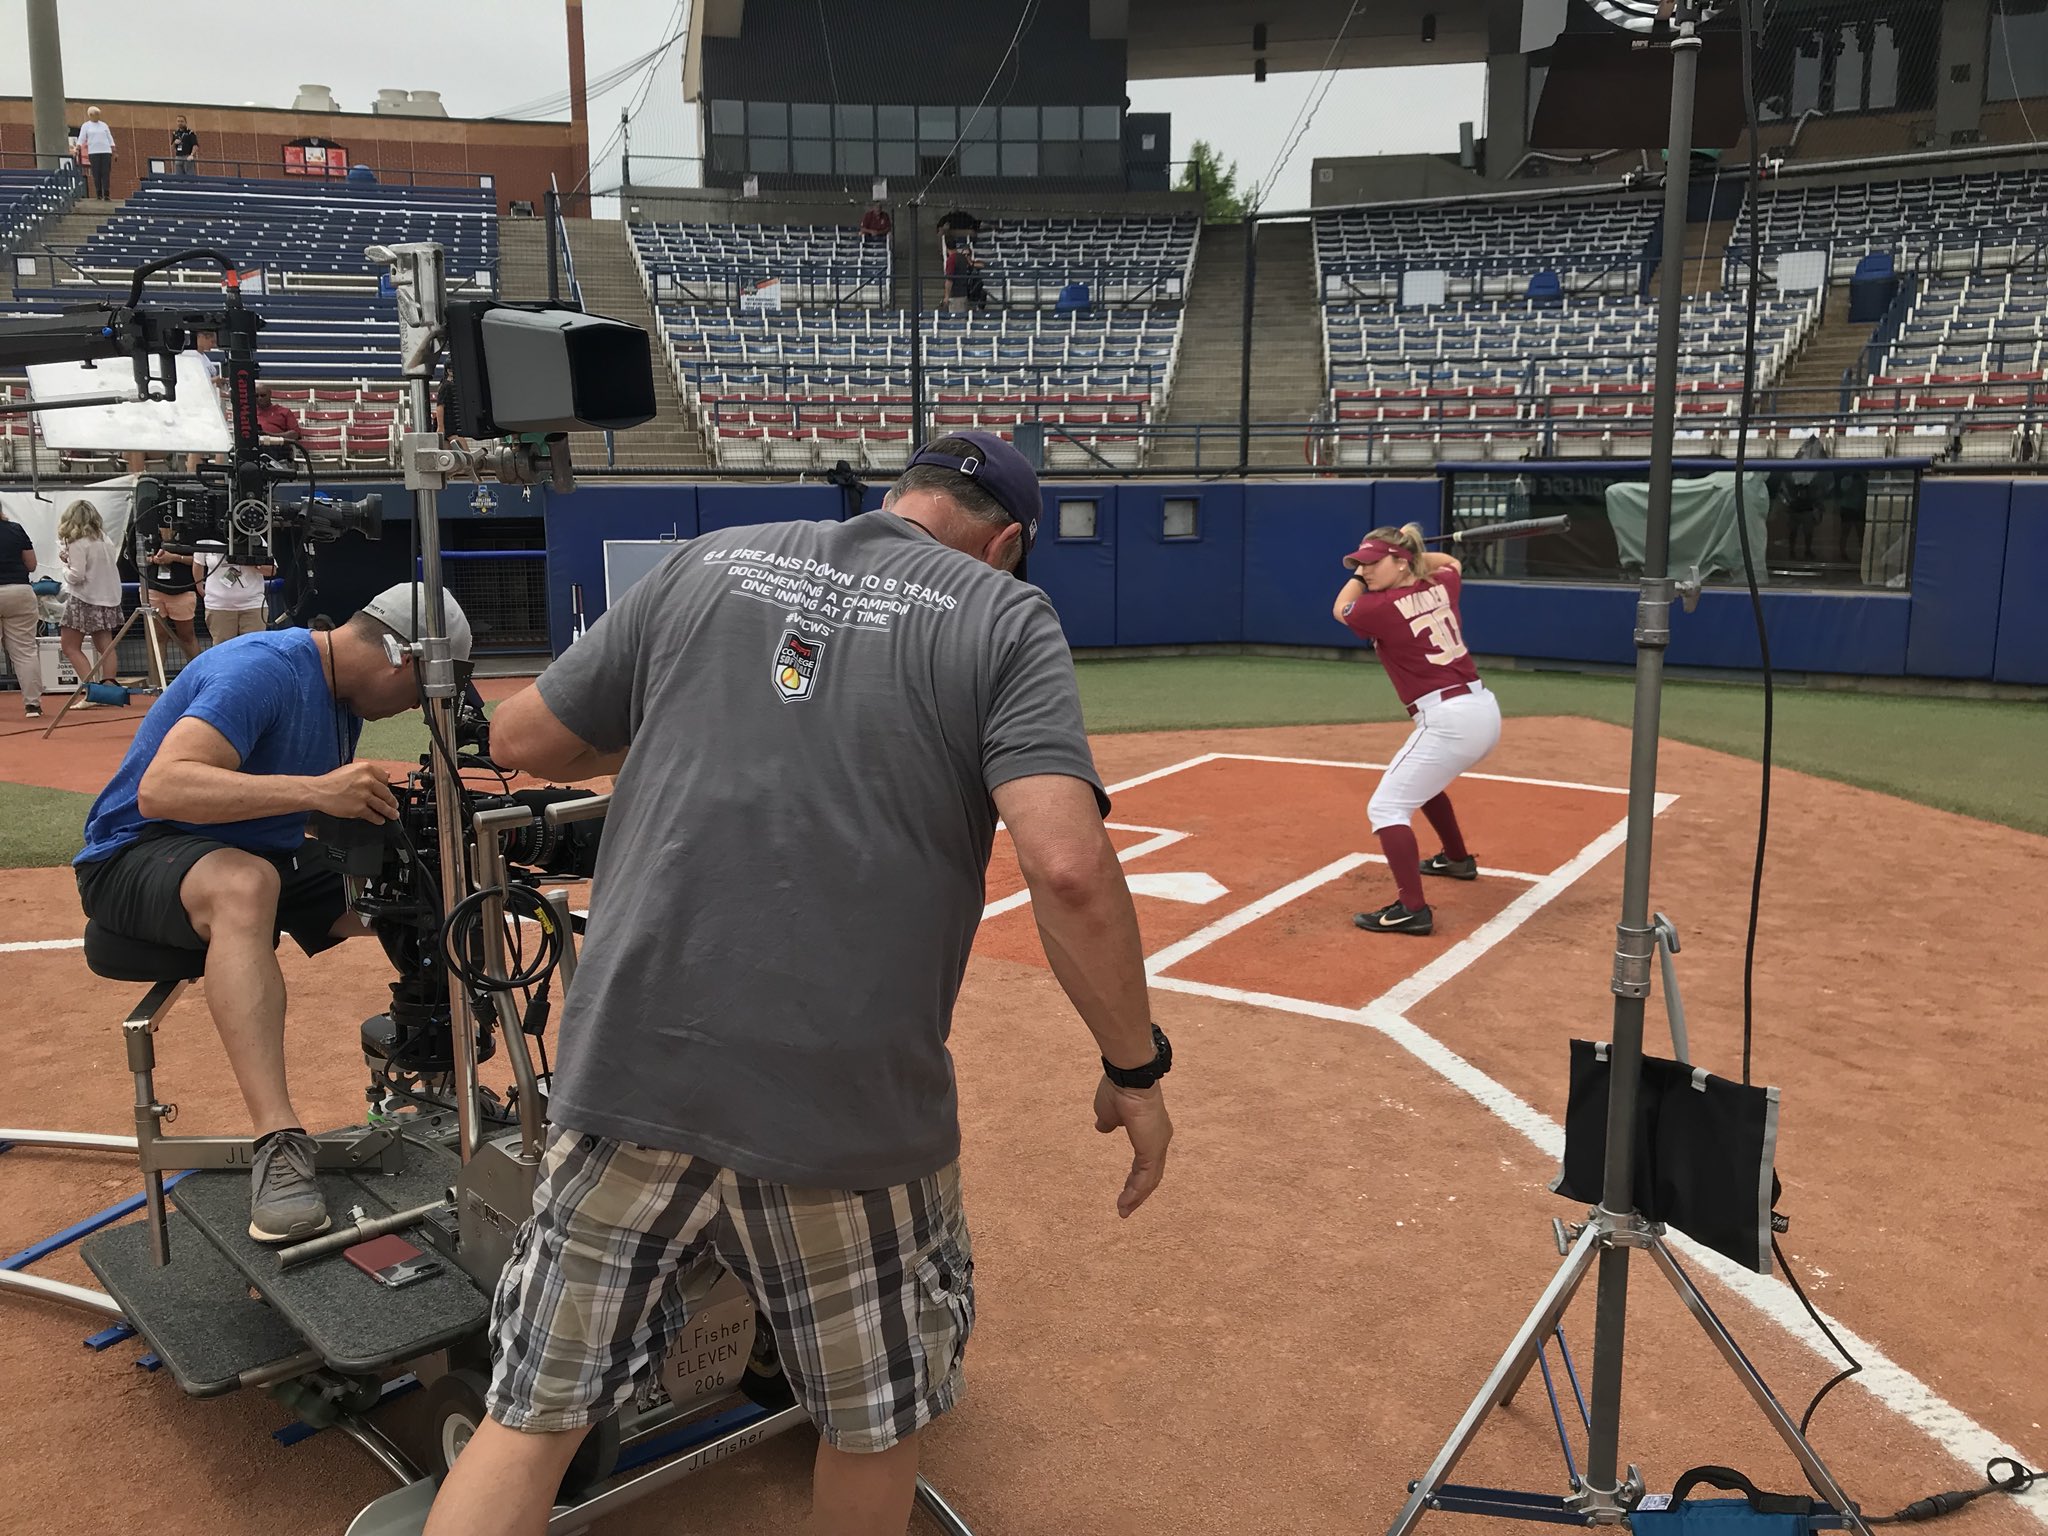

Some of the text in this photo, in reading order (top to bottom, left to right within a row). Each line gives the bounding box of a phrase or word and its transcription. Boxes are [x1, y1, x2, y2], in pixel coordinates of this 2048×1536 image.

[703, 549, 727, 561] 64
[729, 548, 803, 570] DREAMS
[804, 558, 855, 586] DOWN
[883, 578, 898, 592] 8
[902, 581, 957, 610] TEAMS
[728, 566, 824, 597] DOCUMENTING
[826, 591, 838, 604] A
[741, 579, 773, 596] ONE
[820, 602, 841, 619] AT
[842, 609, 852, 621] A
[857, 610, 890, 625] TIME
[694, 1317, 749, 1349] Fisher
[677, 1341, 738, 1378] ELEVEN
[695, 1370, 725, 1395] 206
[715, 1430, 765, 1459] Fisher
